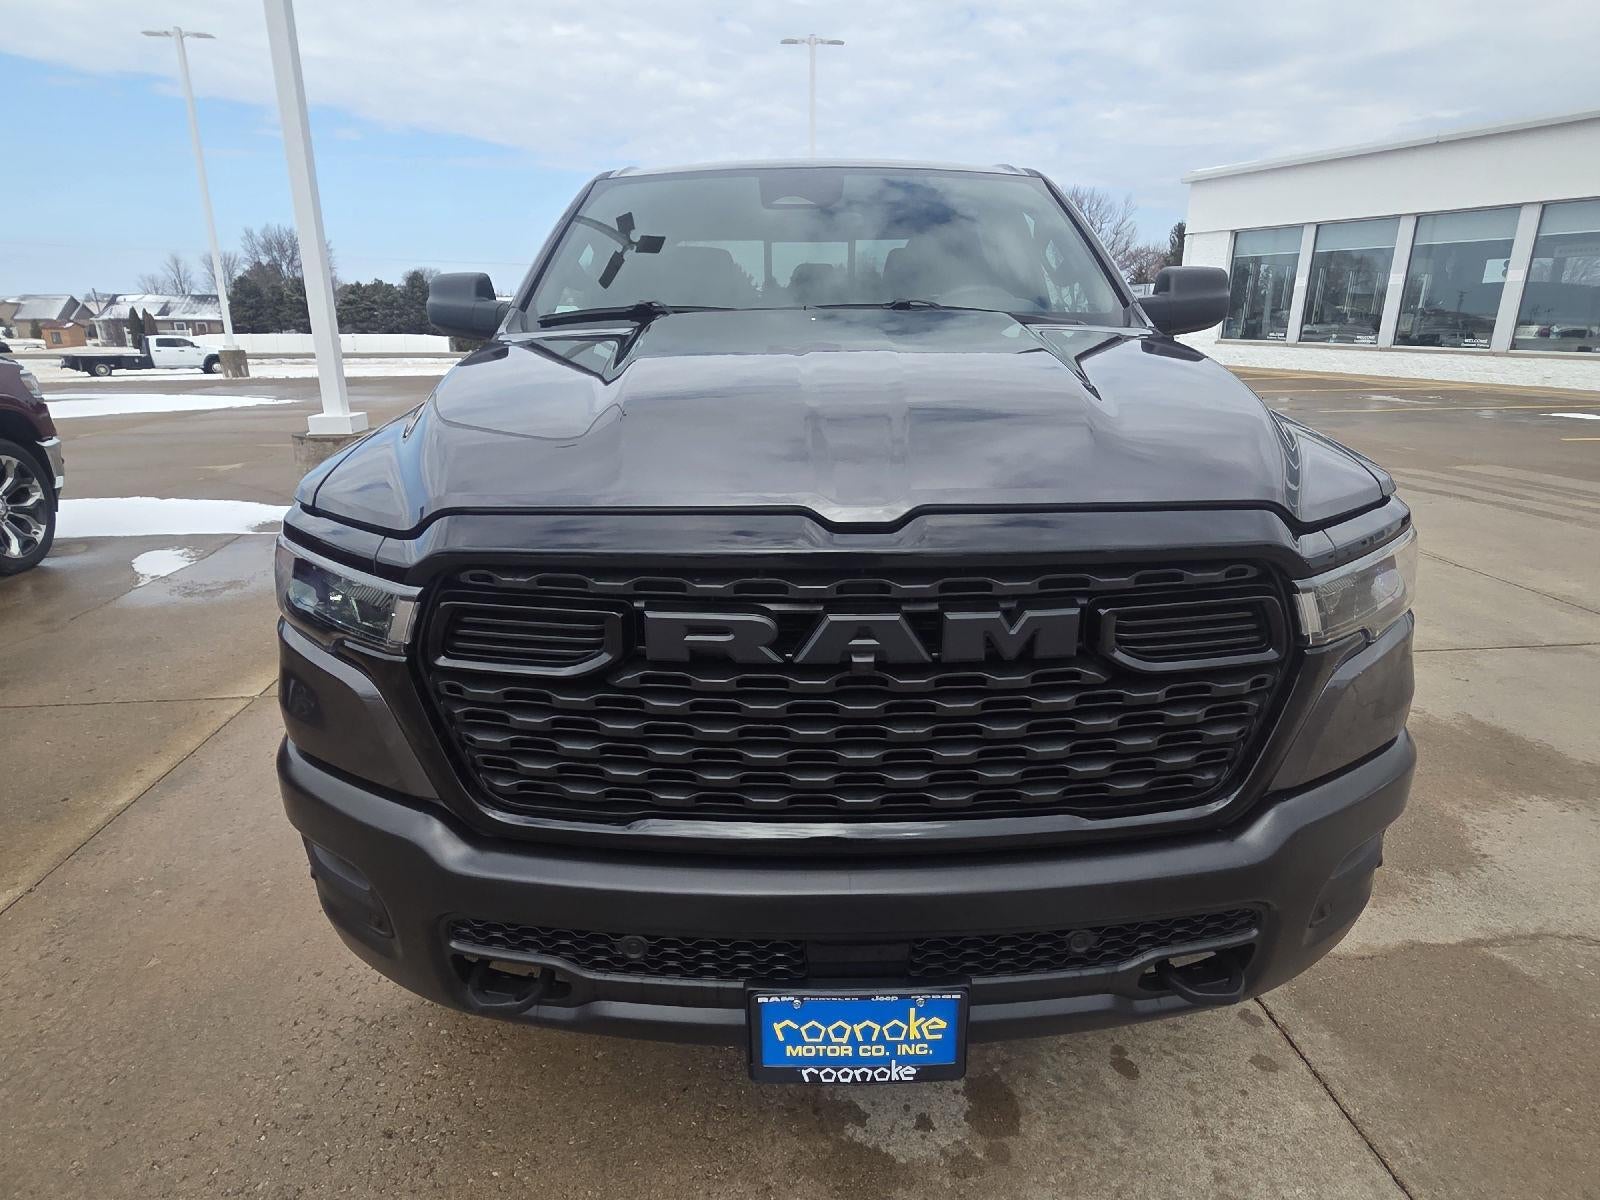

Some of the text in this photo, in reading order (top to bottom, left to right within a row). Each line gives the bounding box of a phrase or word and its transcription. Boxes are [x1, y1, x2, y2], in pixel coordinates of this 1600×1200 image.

[643, 607, 1081, 664] RAM
[773, 1008, 948, 1043] roanoke
[786, 1043, 933, 1057] MOTOR CO. INC.
[801, 1059, 918, 1083] roanoke
